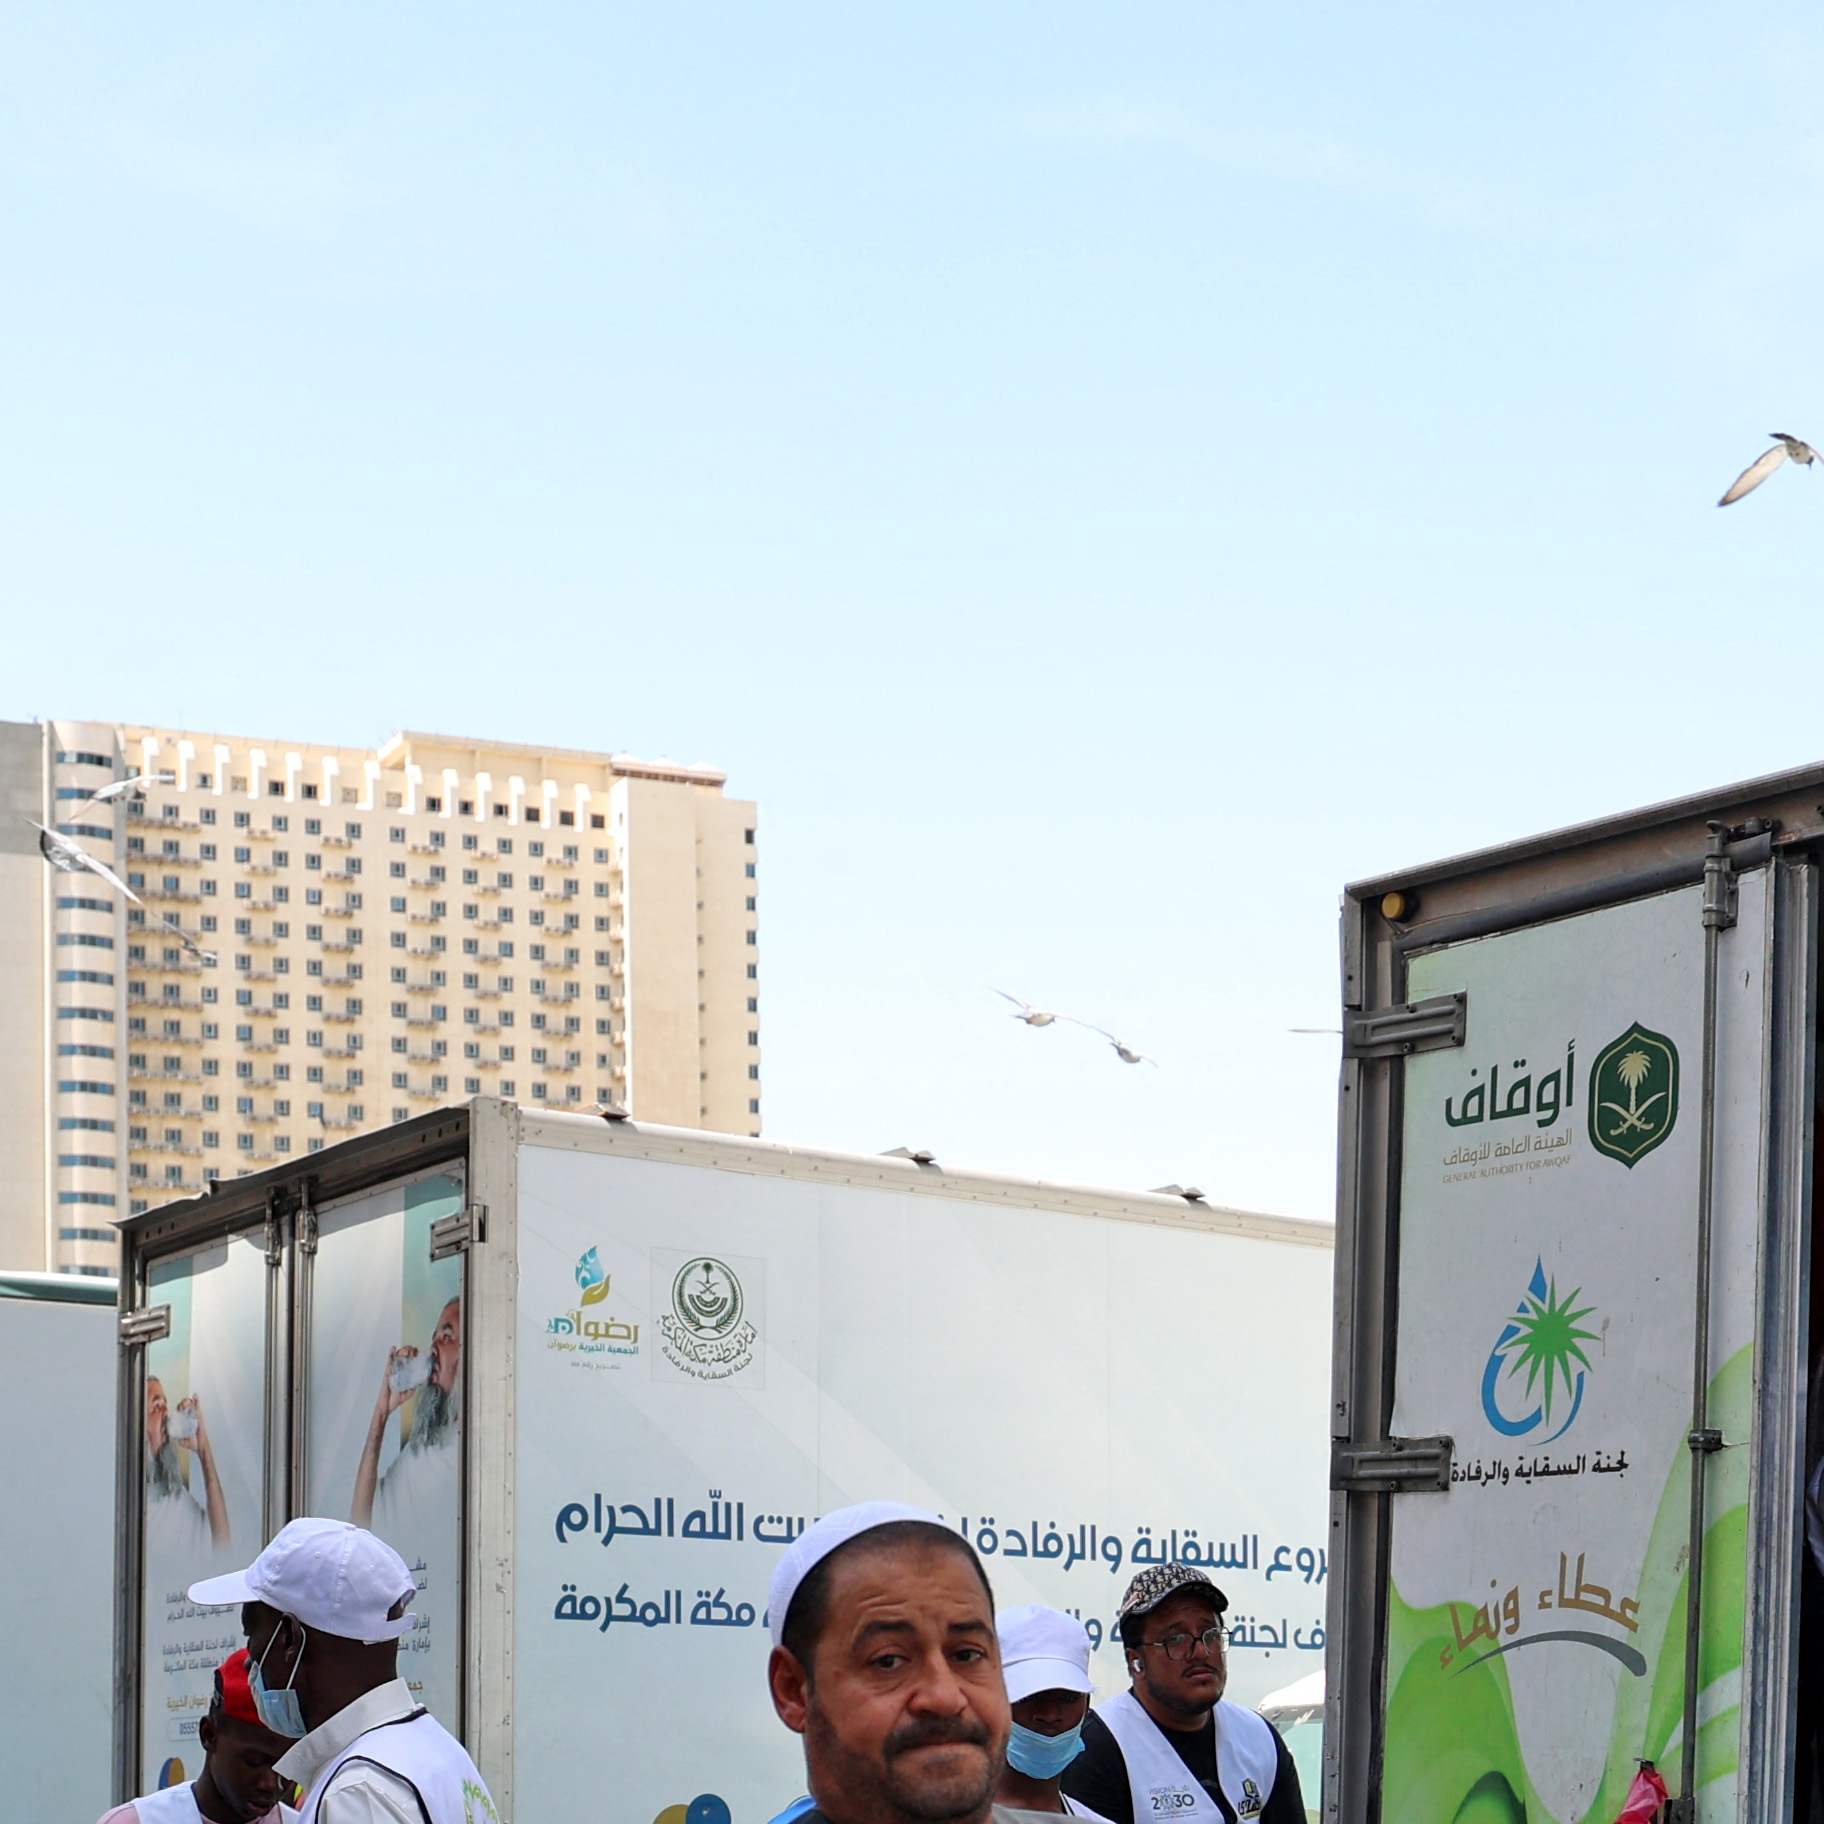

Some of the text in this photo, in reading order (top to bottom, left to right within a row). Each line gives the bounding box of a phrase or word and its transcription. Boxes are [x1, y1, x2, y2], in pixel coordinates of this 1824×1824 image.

[1445, 1038, 1575, 1128] أوقاف
[1495, 1135, 1531, 1157] العامة
[1442, 1170, 1477, 1184] GENERAL
[1479, 1164, 1524, 1179] AUTHORITY
[1451, 1449, 1629, 1487] لجنة السقاية والرفادة
[555, 1493, 674, 1547] الحرام
[976, 1516, 1123, 1575] والرفادة
[1265, 1545, 1328, 1585] روع
[554, 1583, 682, 1633] المكرمة
[690, 1587, 756, 1627] مكة
[1538, 1551, 1641, 1633] عطاء
